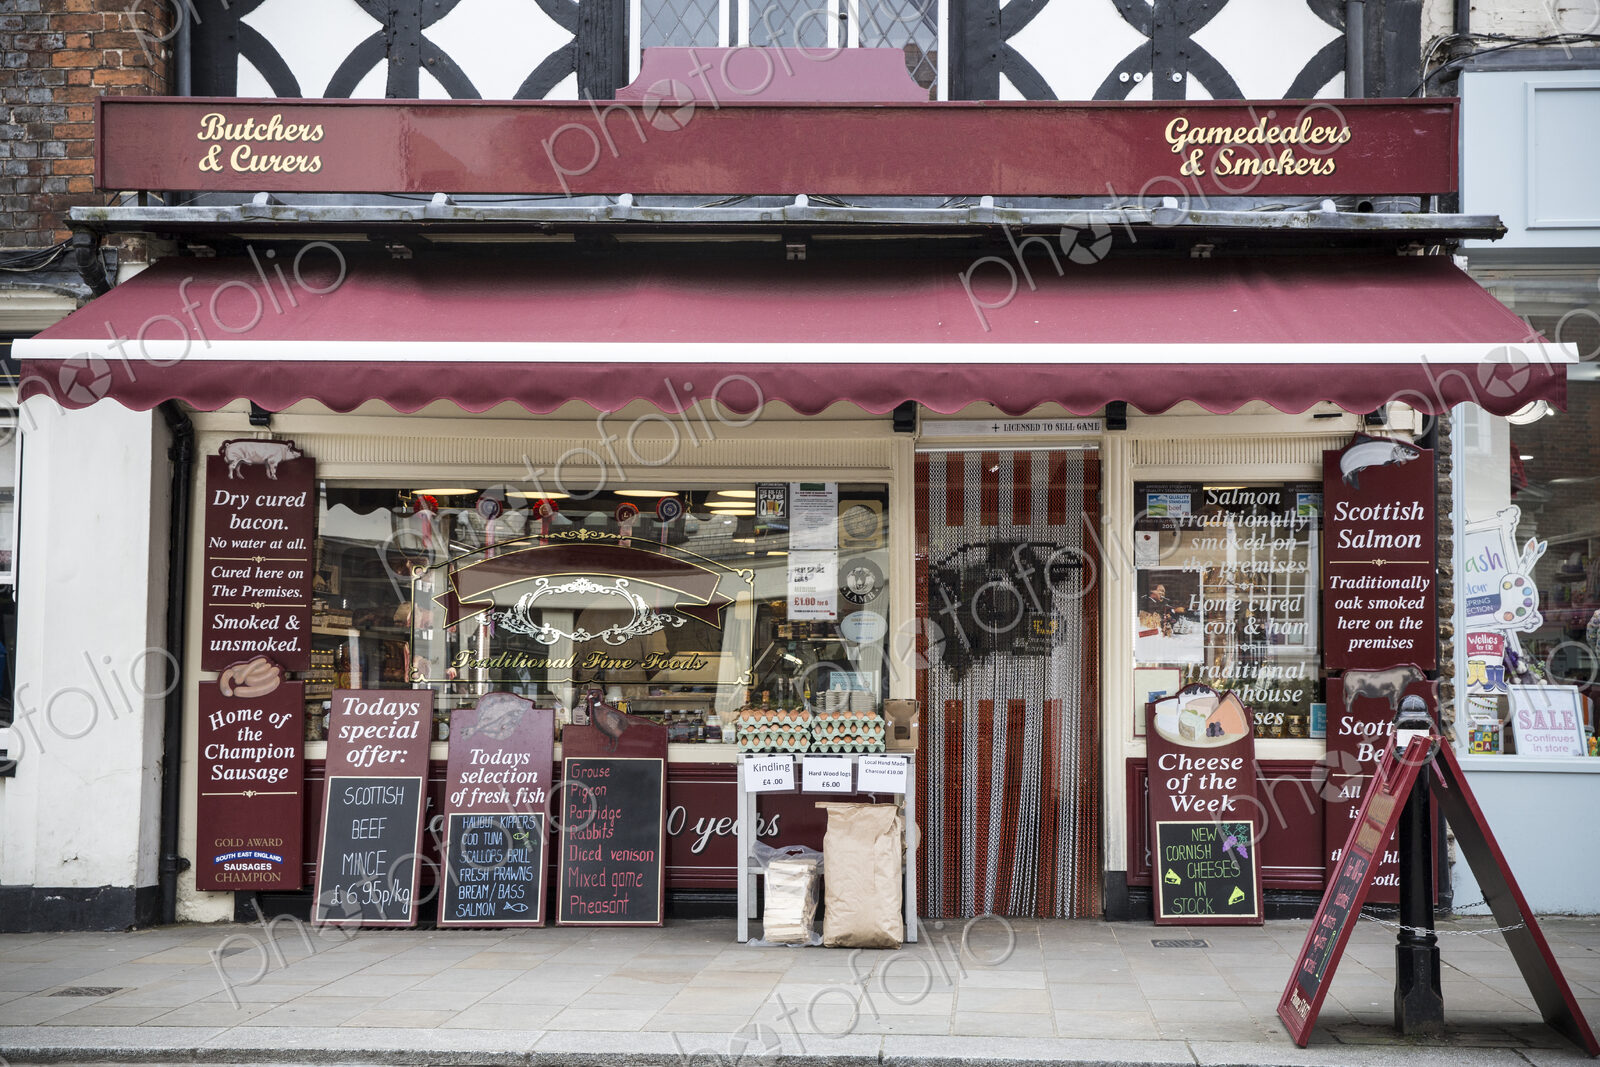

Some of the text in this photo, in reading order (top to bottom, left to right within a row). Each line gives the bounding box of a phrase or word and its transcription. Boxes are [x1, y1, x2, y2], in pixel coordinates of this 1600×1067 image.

[197, 113, 324, 142] Butchers
[1165, 117, 1351, 153] Gamedealers
[198, 144, 321, 172] & Curers
[1180, 148, 1336, 176] & Smokers
[1003, 422, 1100, 432] LICENSED TO SELL GAME
[212, 489, 307, 510] Dry cured
[1206, 488, 1281, 505] Salmon
[1333, 501, 1425, 521] Scottish
[229, 514, 289, 530] bacon.
[208, 537, 307, 550] No water at all.
[1190, 533, 1298, 551] smoked on
[1337, 529, 1422, 549] Salmon
[211, 565, 304, 580] Cured here on
[1182, 556, 1307, 578] the premises
[212, 585, 303, 598] The Premises.
[1329, 575, 1430, 592] Traditionally
[845, 590, 876, 602] LAMB
[1188, 594, 1301, 611] Home cured
[1334, 595, 1425, 610] oak smoked
[212, 613, 301, 630] Smoked &
[1243, 617, 1261, 635] &
[1268, 618, 1309, 635] ham
[1337, 616, 1424, 630] here on the
[209, 636, 302, 652] unsmoked.
[1348, 636, 1414, 652] premises
[1468, 634, 1498, 645] Wellies
[451, 650, 709, 671] Traditional Fine Foods
[1185, 661, 1306, 679] Traditional
[342, 697, 420, 720] Todays
[208, 708, 293, 732] Home of
[1517, 709, 1577, 731] SALE
[237, 727, 263, 742] the
[338, 721, 420, 743] special
[1524, 733, 1575, 744] Continues
[204, 743, 296, 763] Champion
[346, 744, 409, 768] offer:
[1544, 744, 1569, 753] store
[469, 748, 531, 769] Todays
[1158, 753, 1244, 771] Cheese
[211, 764, 289, 783] Sausage
[460, 768, 539, 784] selection
[571, 763, 610, 778] Grouse
[753, 762, 791, 773] Kindling
[840, 770, 850, 778] logs
[1166, 772, 1238, 794] of the
[343, 786, 405, 805] SCOTTISH
[450, 787, 545, 807] of fresh fish
[570, 783, 607, 803] Pigeon
[1338, 785, 1361, 799] All
[1168, 794, 1237, 813] Week
[462, 816, 495, 829] HALIBUT
[500, 816, 536, 829] KIPPERS
[569, 804, 622, 826] Partridge
[351, 817, 388, 840] BEEF
[569, 823, 614, 840] Rabbits
[1191, 828, 1218, 842] NEW
[214, 837, 283, 848] GOLD AWARD
[483, 832, 503, 846] TUNA
[215, 852, 236, 863] SOUTH
[253, 851, 282, 863] ENGLAND
[460, 848, 531, 863] SCALLOPS BRILL
[568, 844, 654, 862] Diced venison
[1166, 844, 1212, 861] CORNISH
[223, 862, 272, 871] SAUSAGES
[341, 850, 388, 876] MINCE
[1187, 860, 1240, 879] CHEESES
[214, 871, 281, 883] CHAMPION
[460, 866, 534, 882] FRESH PRAWNS
[568, 867, 643, 897] Mixed game
[1194, 881, 1206, 897] IN
[455, 902, 496, 917] SALMON
[570, 892, 629, 915] Pheasant
[1171, 897, 1215, 915] STOCK
